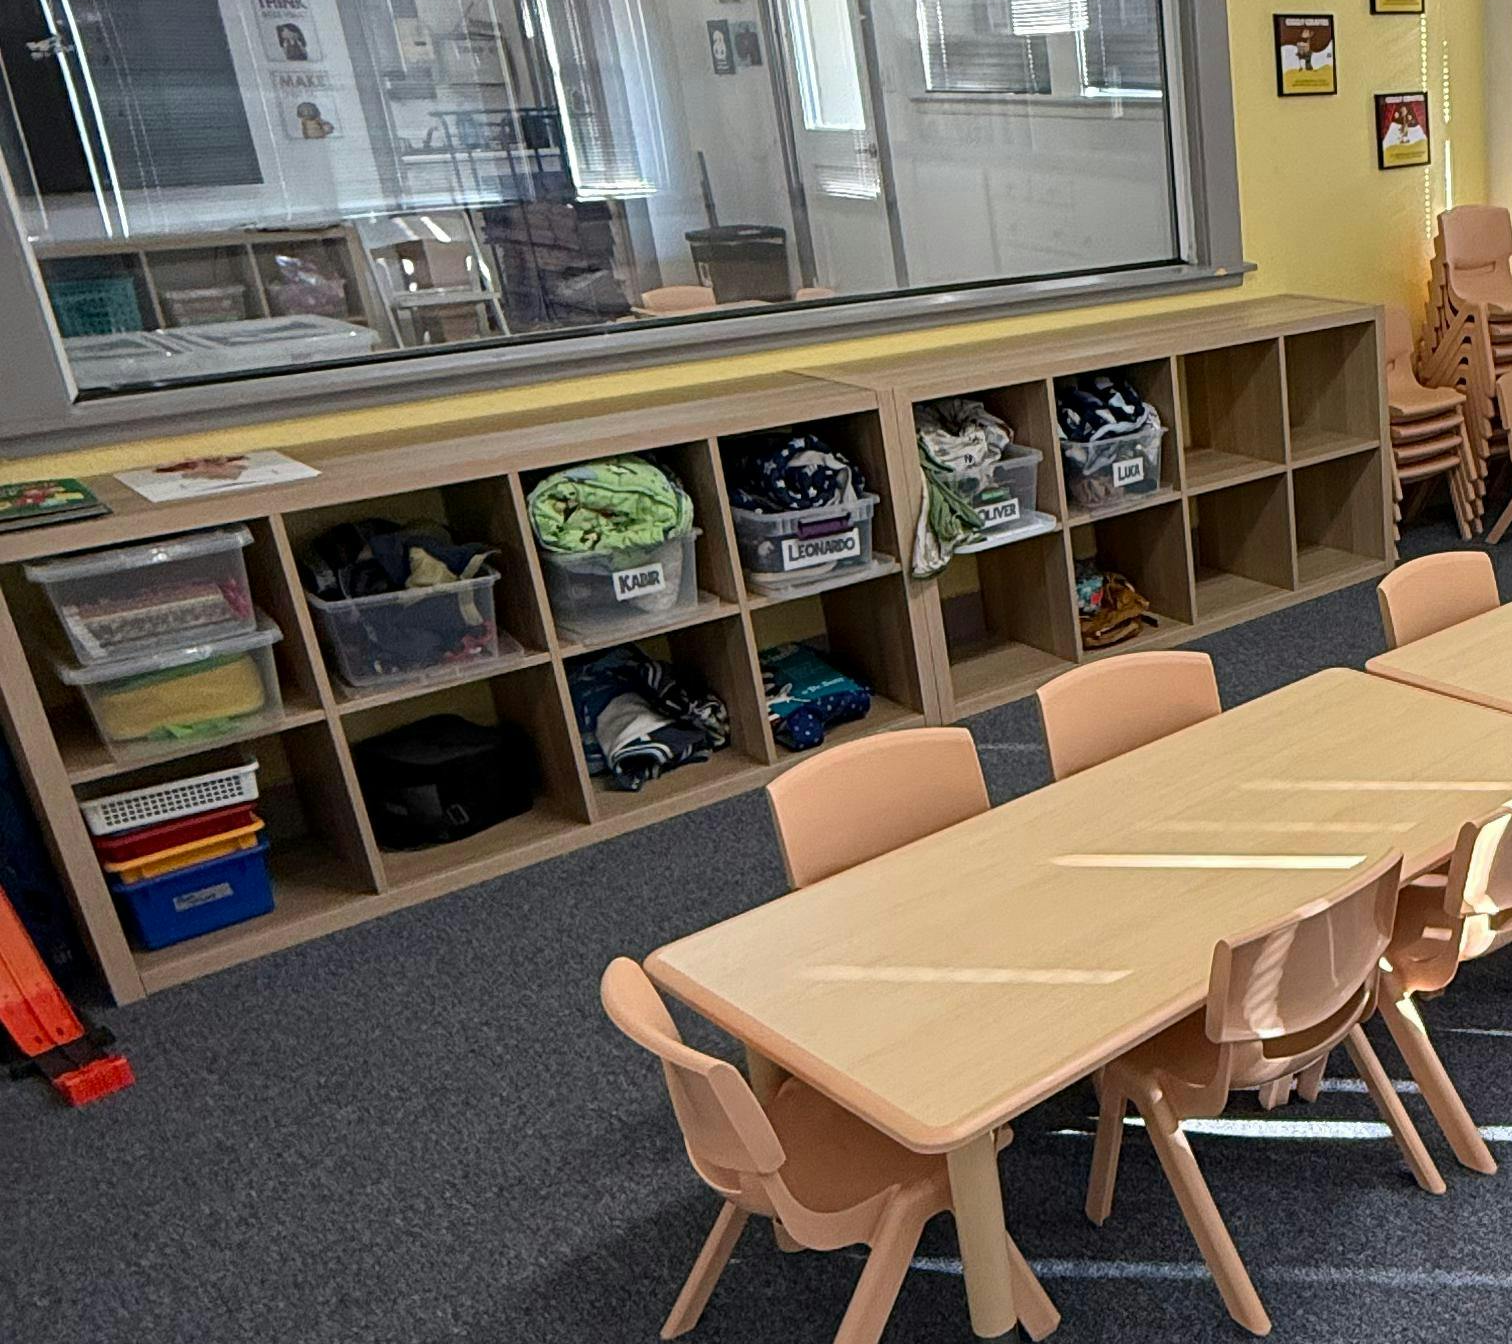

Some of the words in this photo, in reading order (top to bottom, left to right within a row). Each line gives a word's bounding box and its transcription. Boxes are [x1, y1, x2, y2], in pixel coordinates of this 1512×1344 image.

[279, 74, 328, 88] MAKE
[1118, 463, 1141, 482] LUCA
[979, 503, 1017, 522] OLIVER
[788, 536, 856, 562] LEONARDO
[618, 569, 661, 594] KABIR
